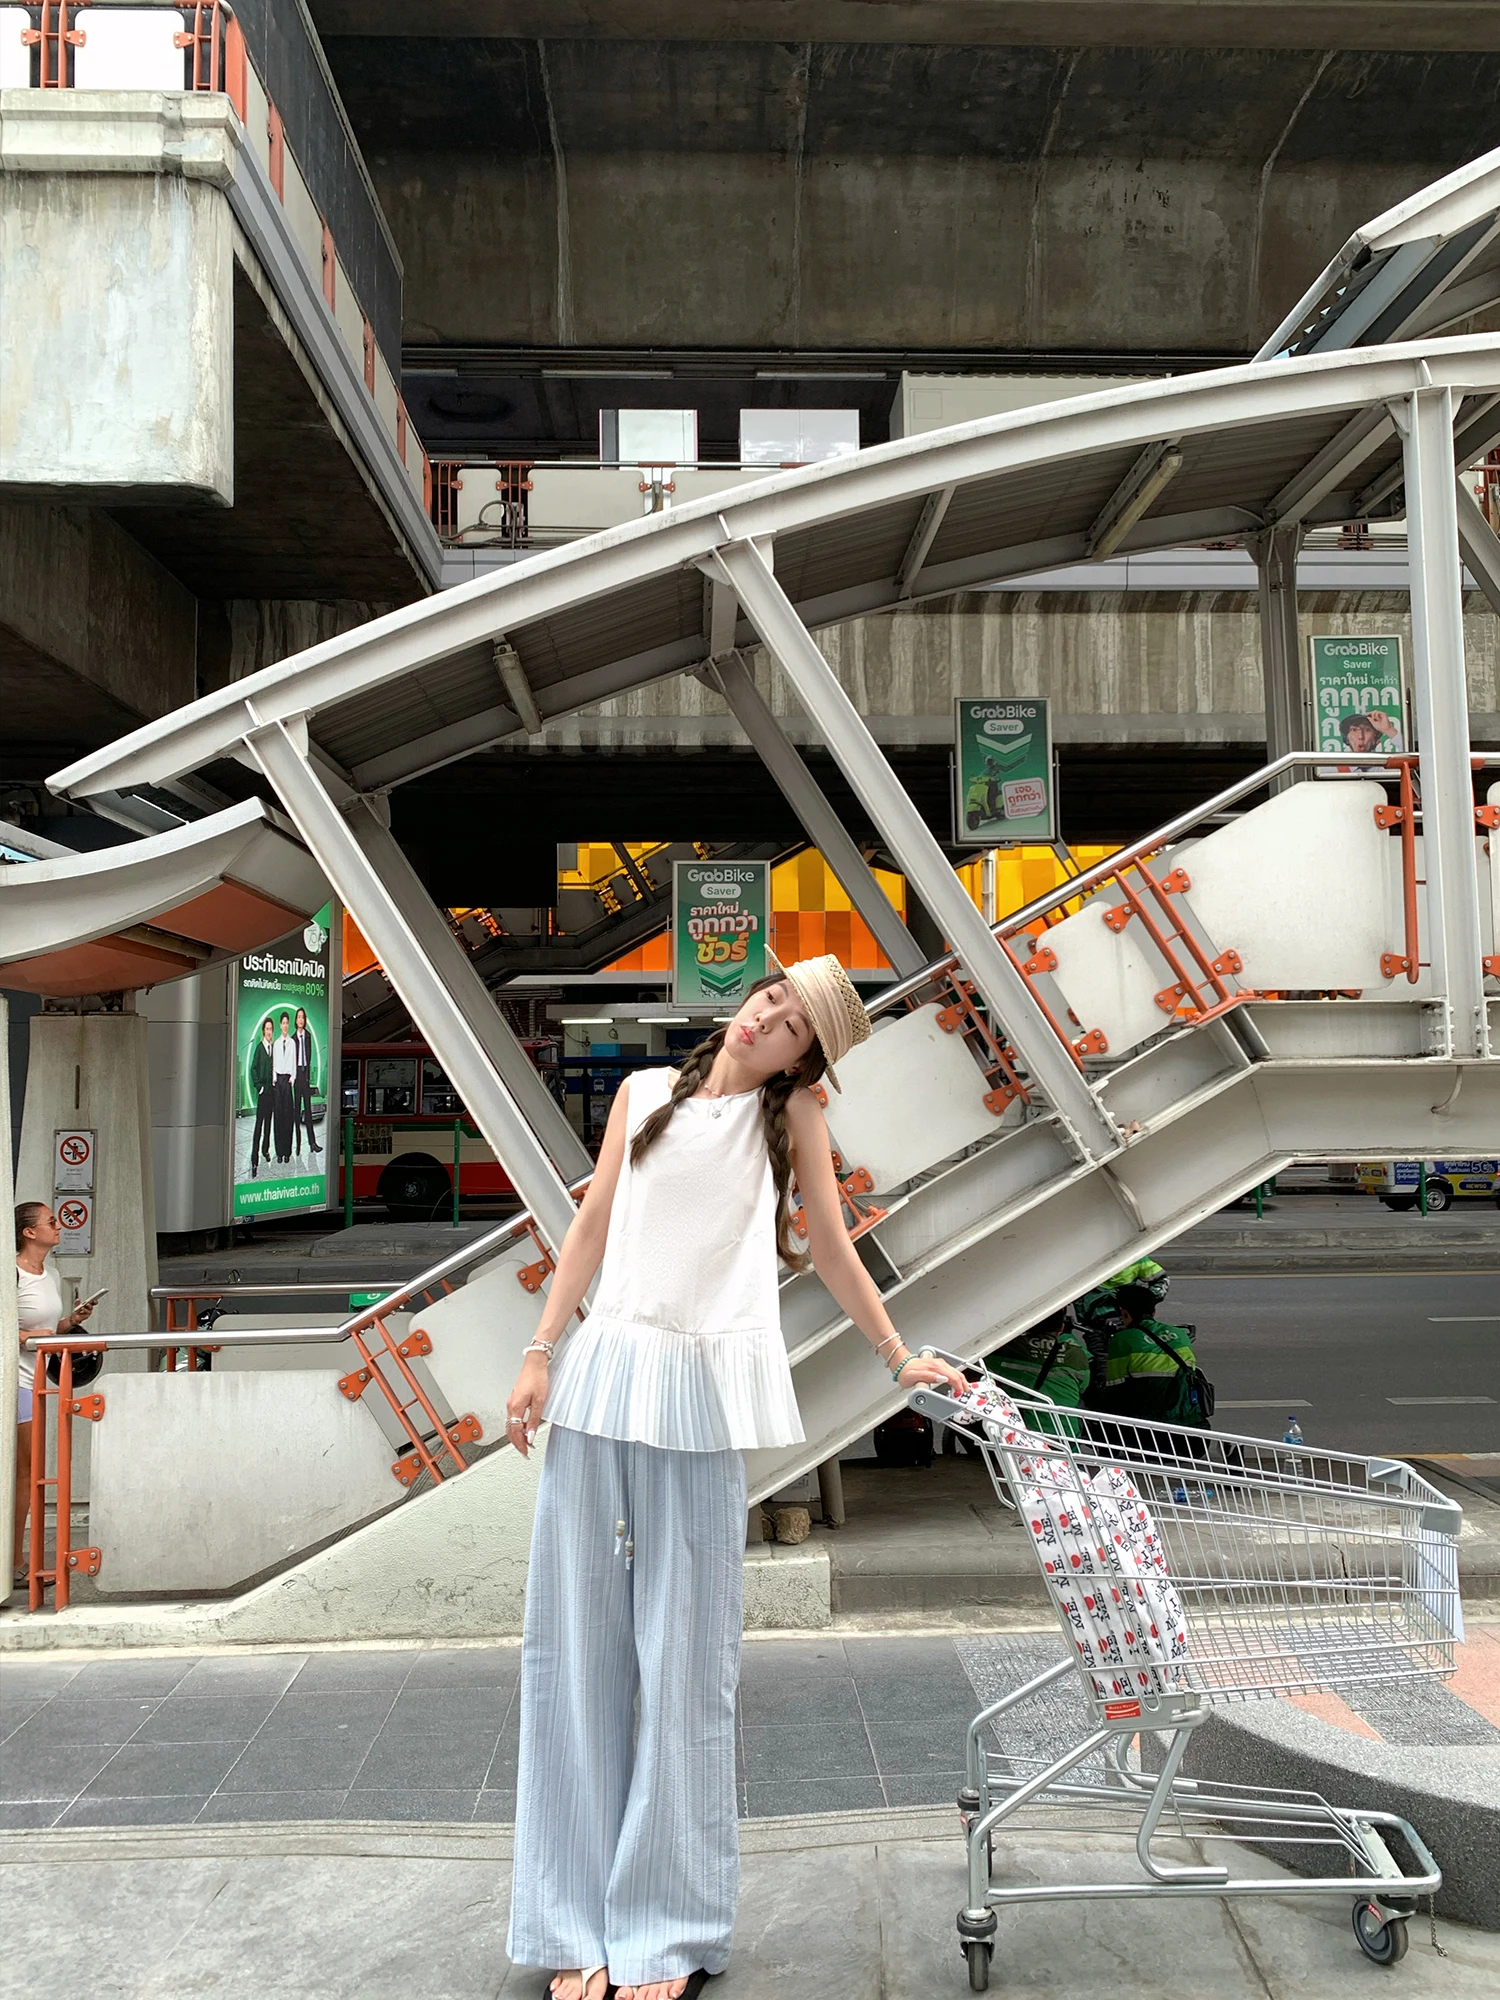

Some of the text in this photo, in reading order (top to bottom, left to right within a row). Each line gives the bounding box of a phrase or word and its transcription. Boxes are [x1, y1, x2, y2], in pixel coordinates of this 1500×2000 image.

[1324, 642, 1388, 656] GrabBike
[1343, 660, 1372, 669] Saver
[1320, 672, 1368, 686] ราคาใหม่
[970, 704, 1036, 718] GrabBike
[990, 722, 1018, 732] Saver
[1014, 785, 1032, 794] เจอ
[1008, 790, 1041, 806] ถูกกว่า
[687, 868, 755, 882] GrabBike
[706, 886, 736, 896] Saver
[690, 902, 739, 916] ราคาใหม่
[687, 910, 758, 941] ถูกกว่า
[697, 932, 749, 964] ชัวร์
[243, 953, 325, 979] ประกันรถเปิดปิด
[306, 982, 324, 996] 80%
[240, 1183, 320, 1204] www.thaivivat.co.th
[1144, 1330, 1178, 1344] Gab
